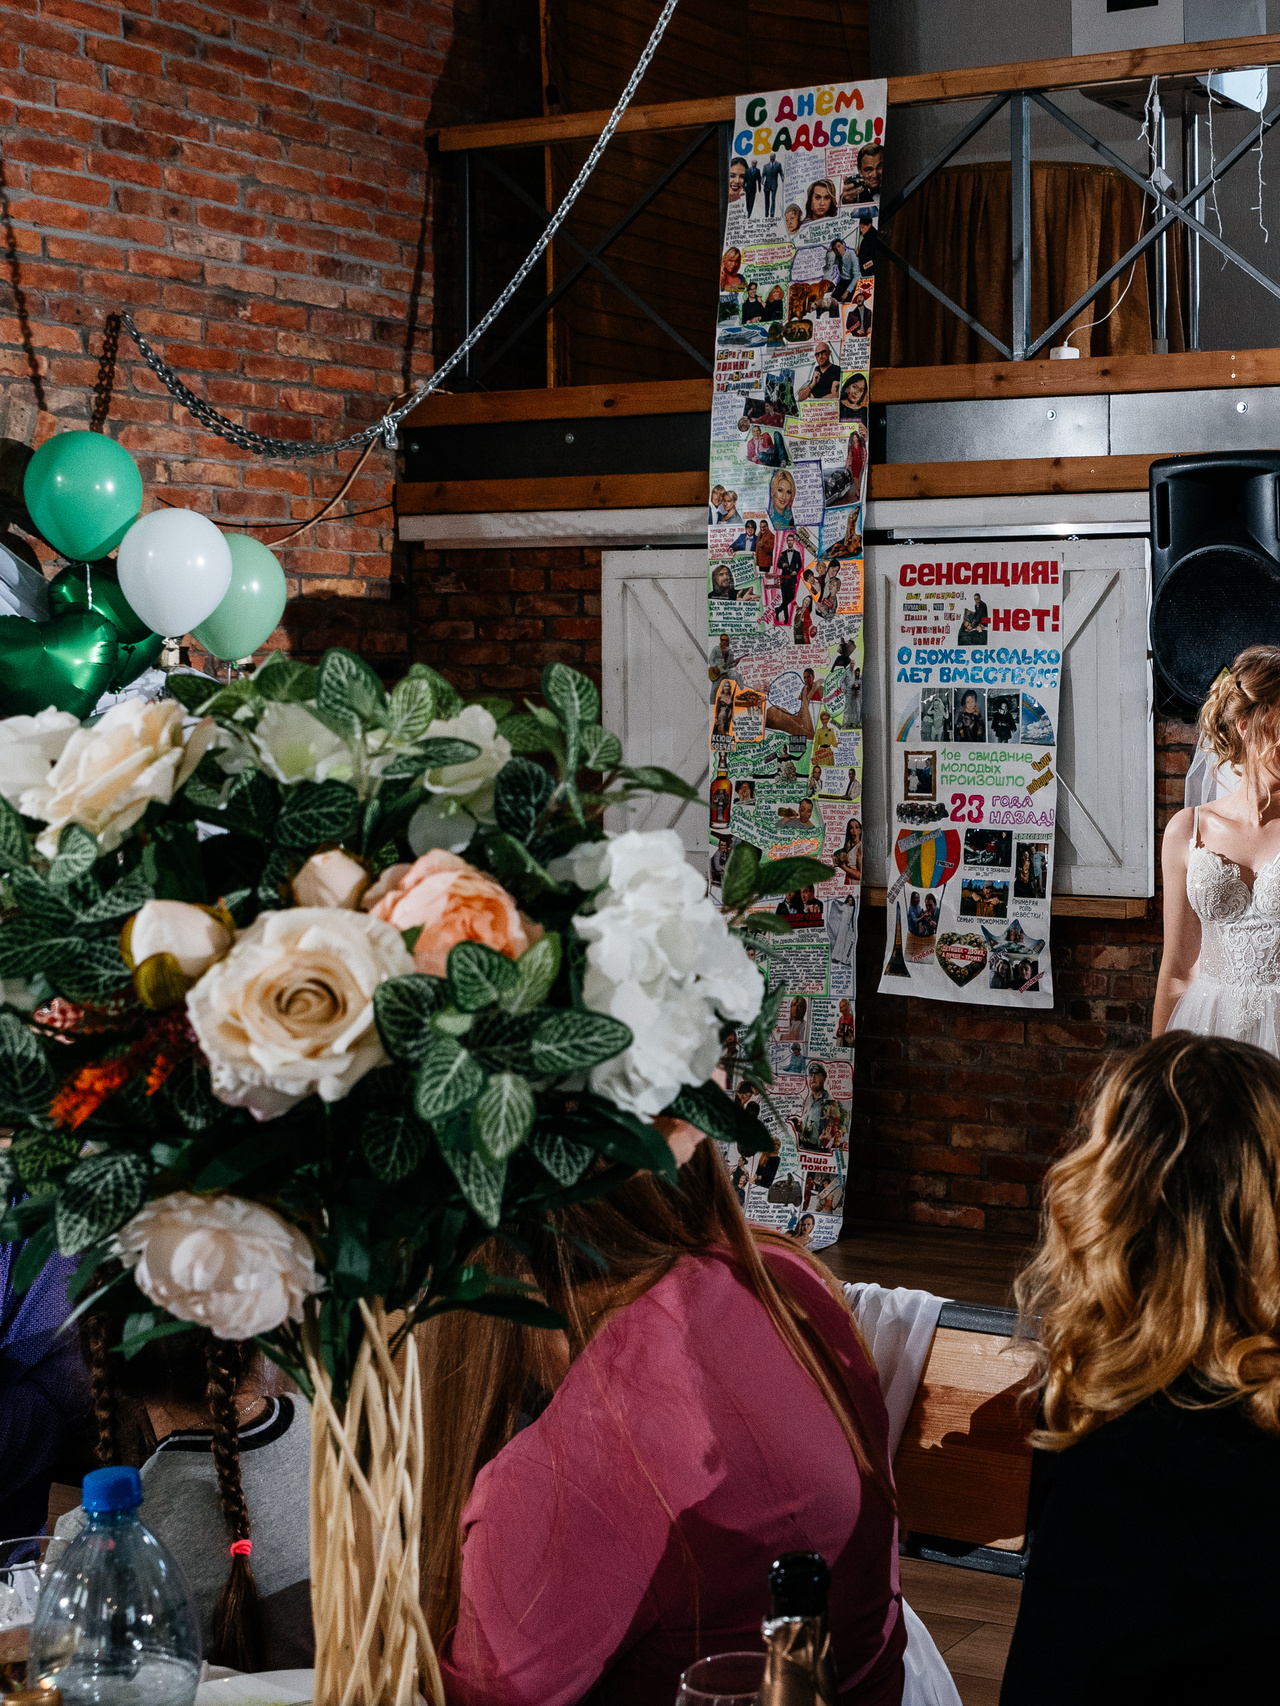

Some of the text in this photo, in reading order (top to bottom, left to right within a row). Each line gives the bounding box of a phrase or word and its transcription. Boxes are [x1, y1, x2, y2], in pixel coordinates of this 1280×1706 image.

[746, 97, 767, 127] С
[734, 117, 883, 156] СВАДЬБЫ!
[899, 561, 1059, 587] СЕНСАЦИЯ!
[897, 646, 1060, 666] О БОЖЕ, СКОЛЬКО
[897, 667, 932, 683] ЛЕТ
[968, 750, 1033, 763] свидание
[950, 793, 985, 823] 23
[989, 809, 1055, 827] НАЗАД!
[800, 1155, 828, 1165] Паша
[801, 1164, 836, 1172] может!
